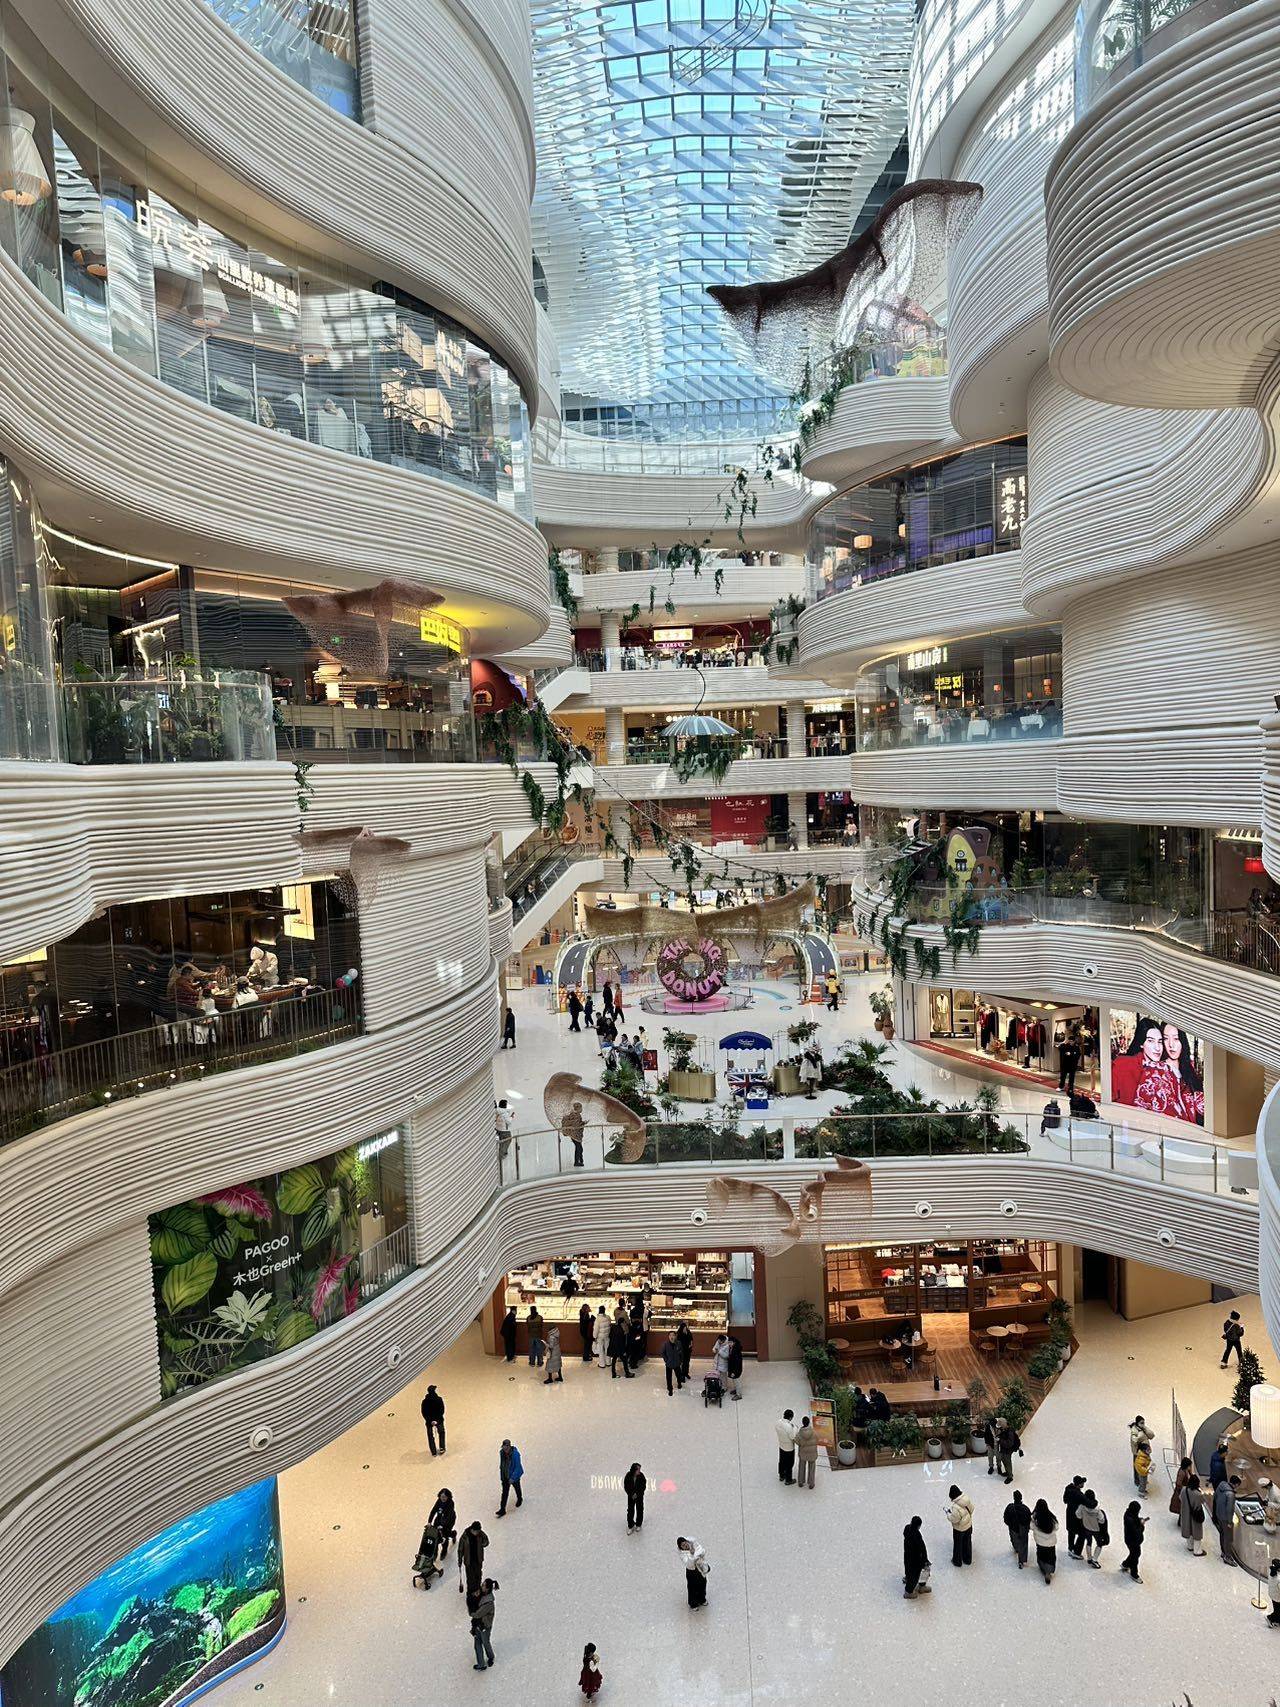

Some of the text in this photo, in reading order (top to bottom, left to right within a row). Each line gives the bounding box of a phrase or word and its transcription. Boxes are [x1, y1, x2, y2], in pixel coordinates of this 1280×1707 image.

[1001, 477, 1018, 532] 高老九
[662, 970, 722, 996] DONUT
[244, 1235, 290, 1260] PAGOO
